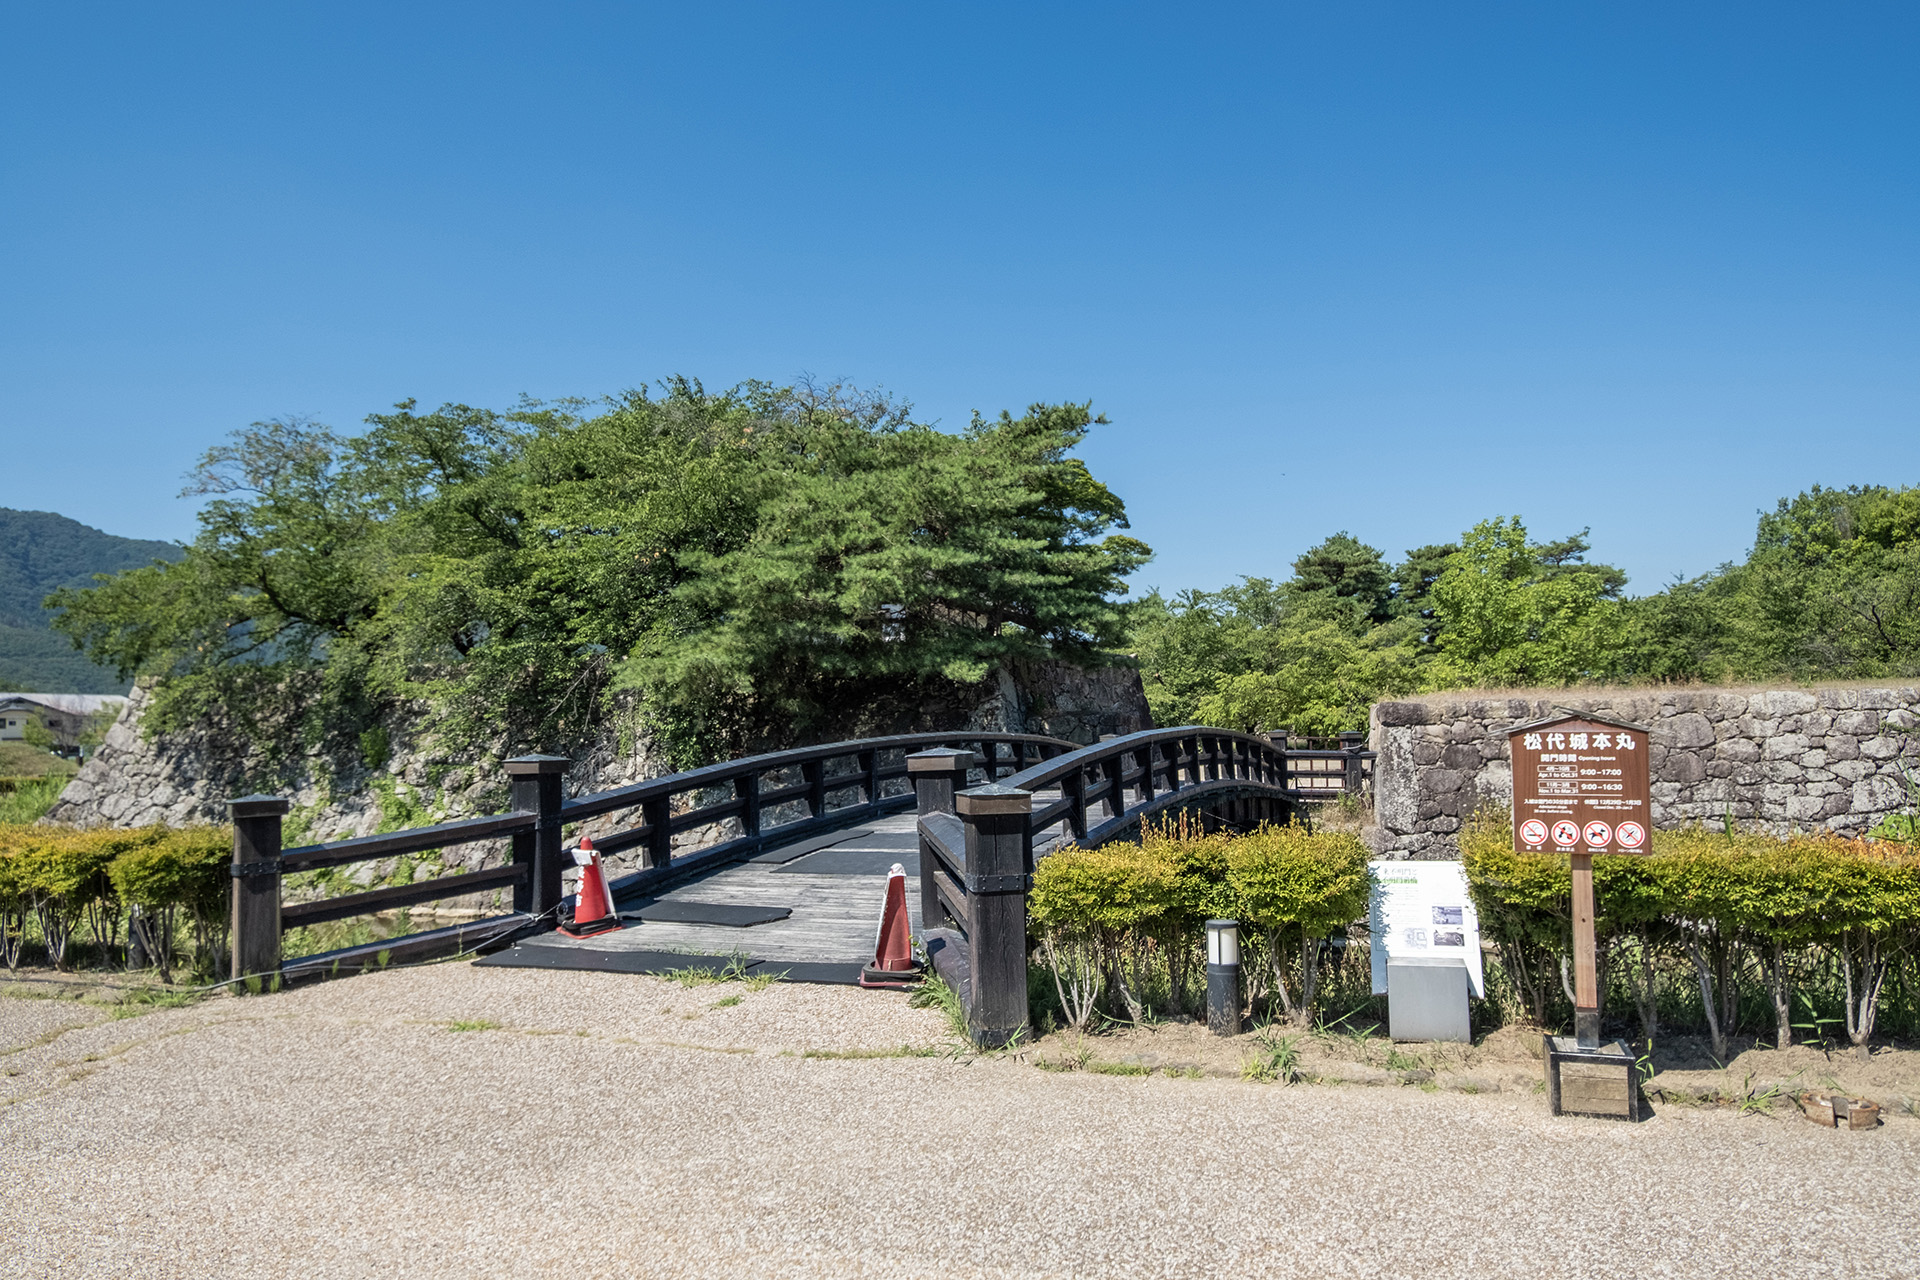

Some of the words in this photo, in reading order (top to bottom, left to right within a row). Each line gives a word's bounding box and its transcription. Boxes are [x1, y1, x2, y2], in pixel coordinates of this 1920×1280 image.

[1523, 733, 1636, 750] 松代城本丸
